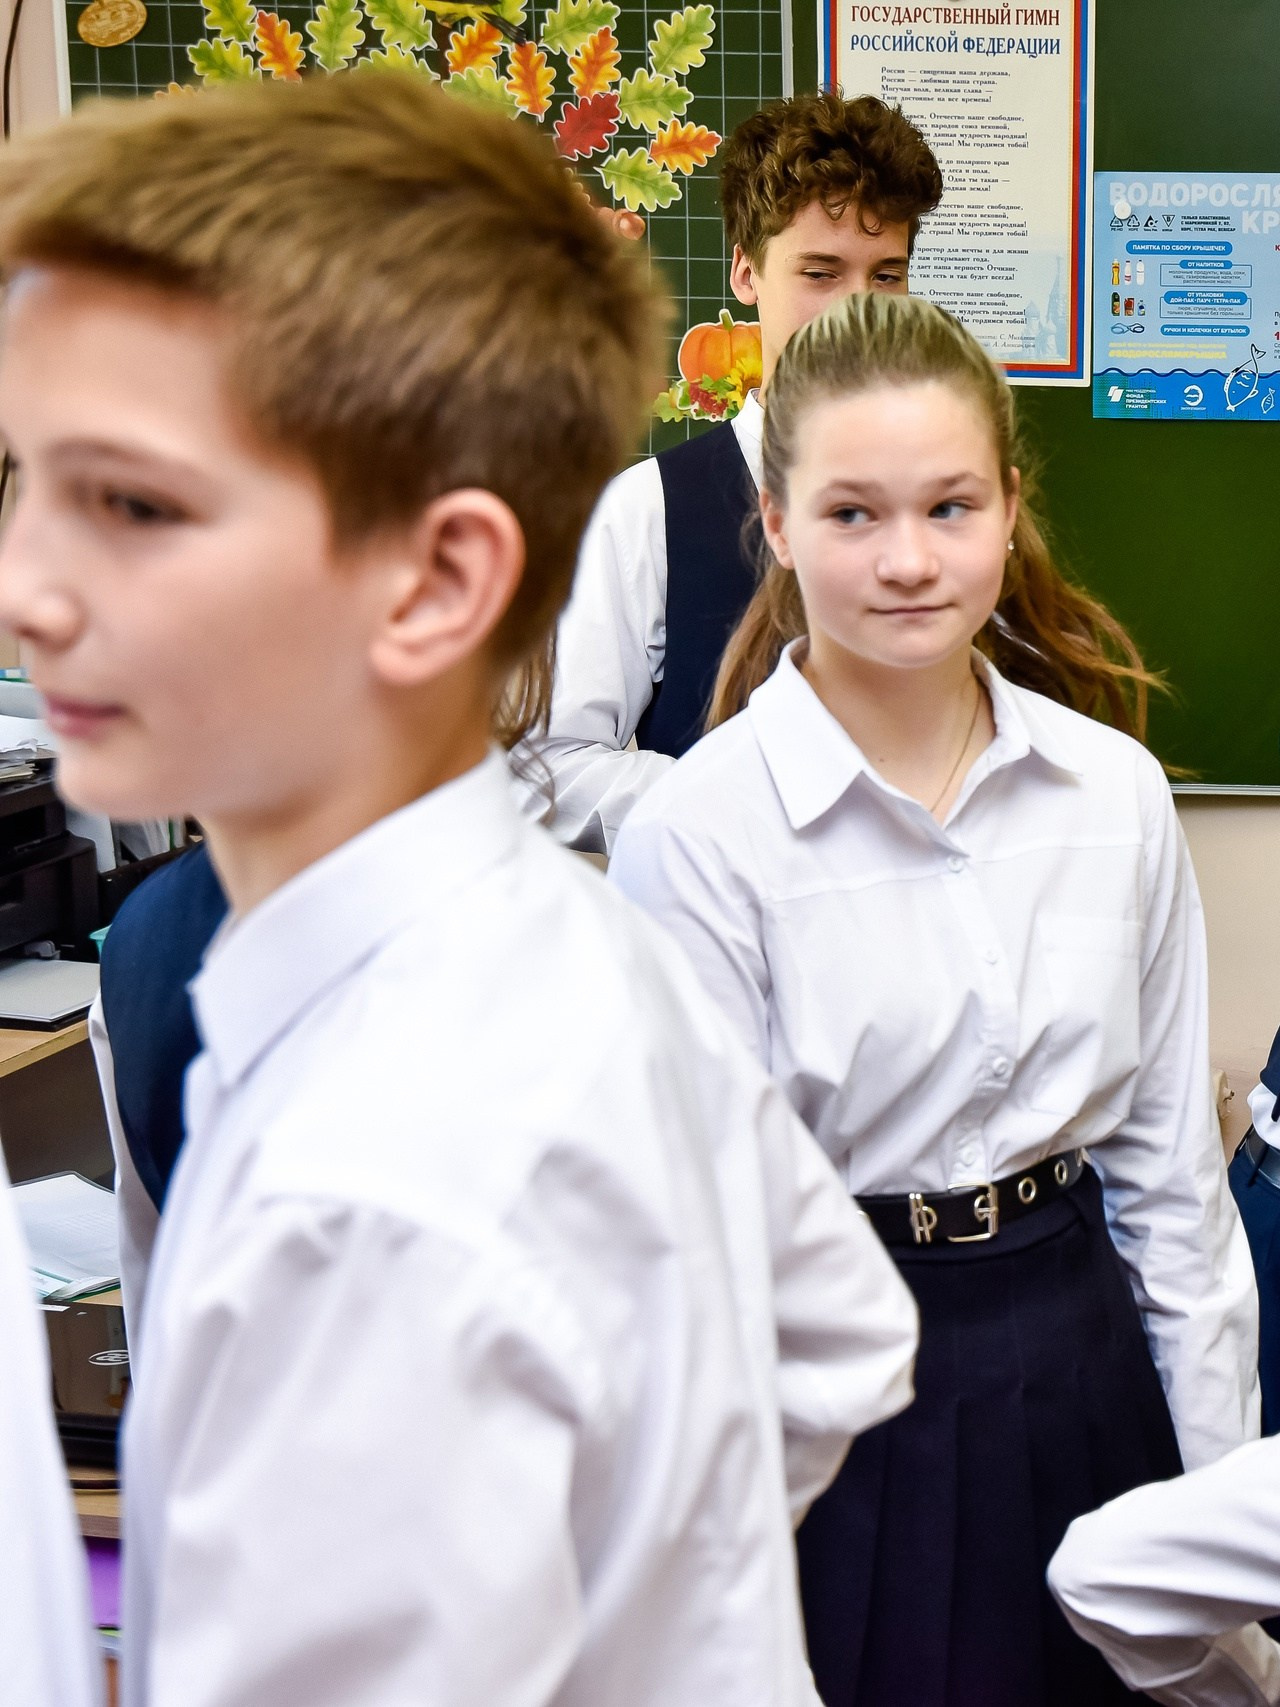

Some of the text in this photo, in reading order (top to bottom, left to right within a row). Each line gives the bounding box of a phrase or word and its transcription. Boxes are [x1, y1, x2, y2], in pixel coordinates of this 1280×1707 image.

[851, 3, 1060, 26] ГОСУДАРСТВЕННЫЙ ГИМН
[850, 29, 1060, 58] РОССИЙСКОЙ ФЕДЕРАЦИИ
[881, 66, 905, 74] Россия
[881, 85, 910, 93] Могучая
[994, 132, 1028, 140] народная!
[947, 175, 966, 183] Одна
[1007, 229, 1028, 237] тобой!
